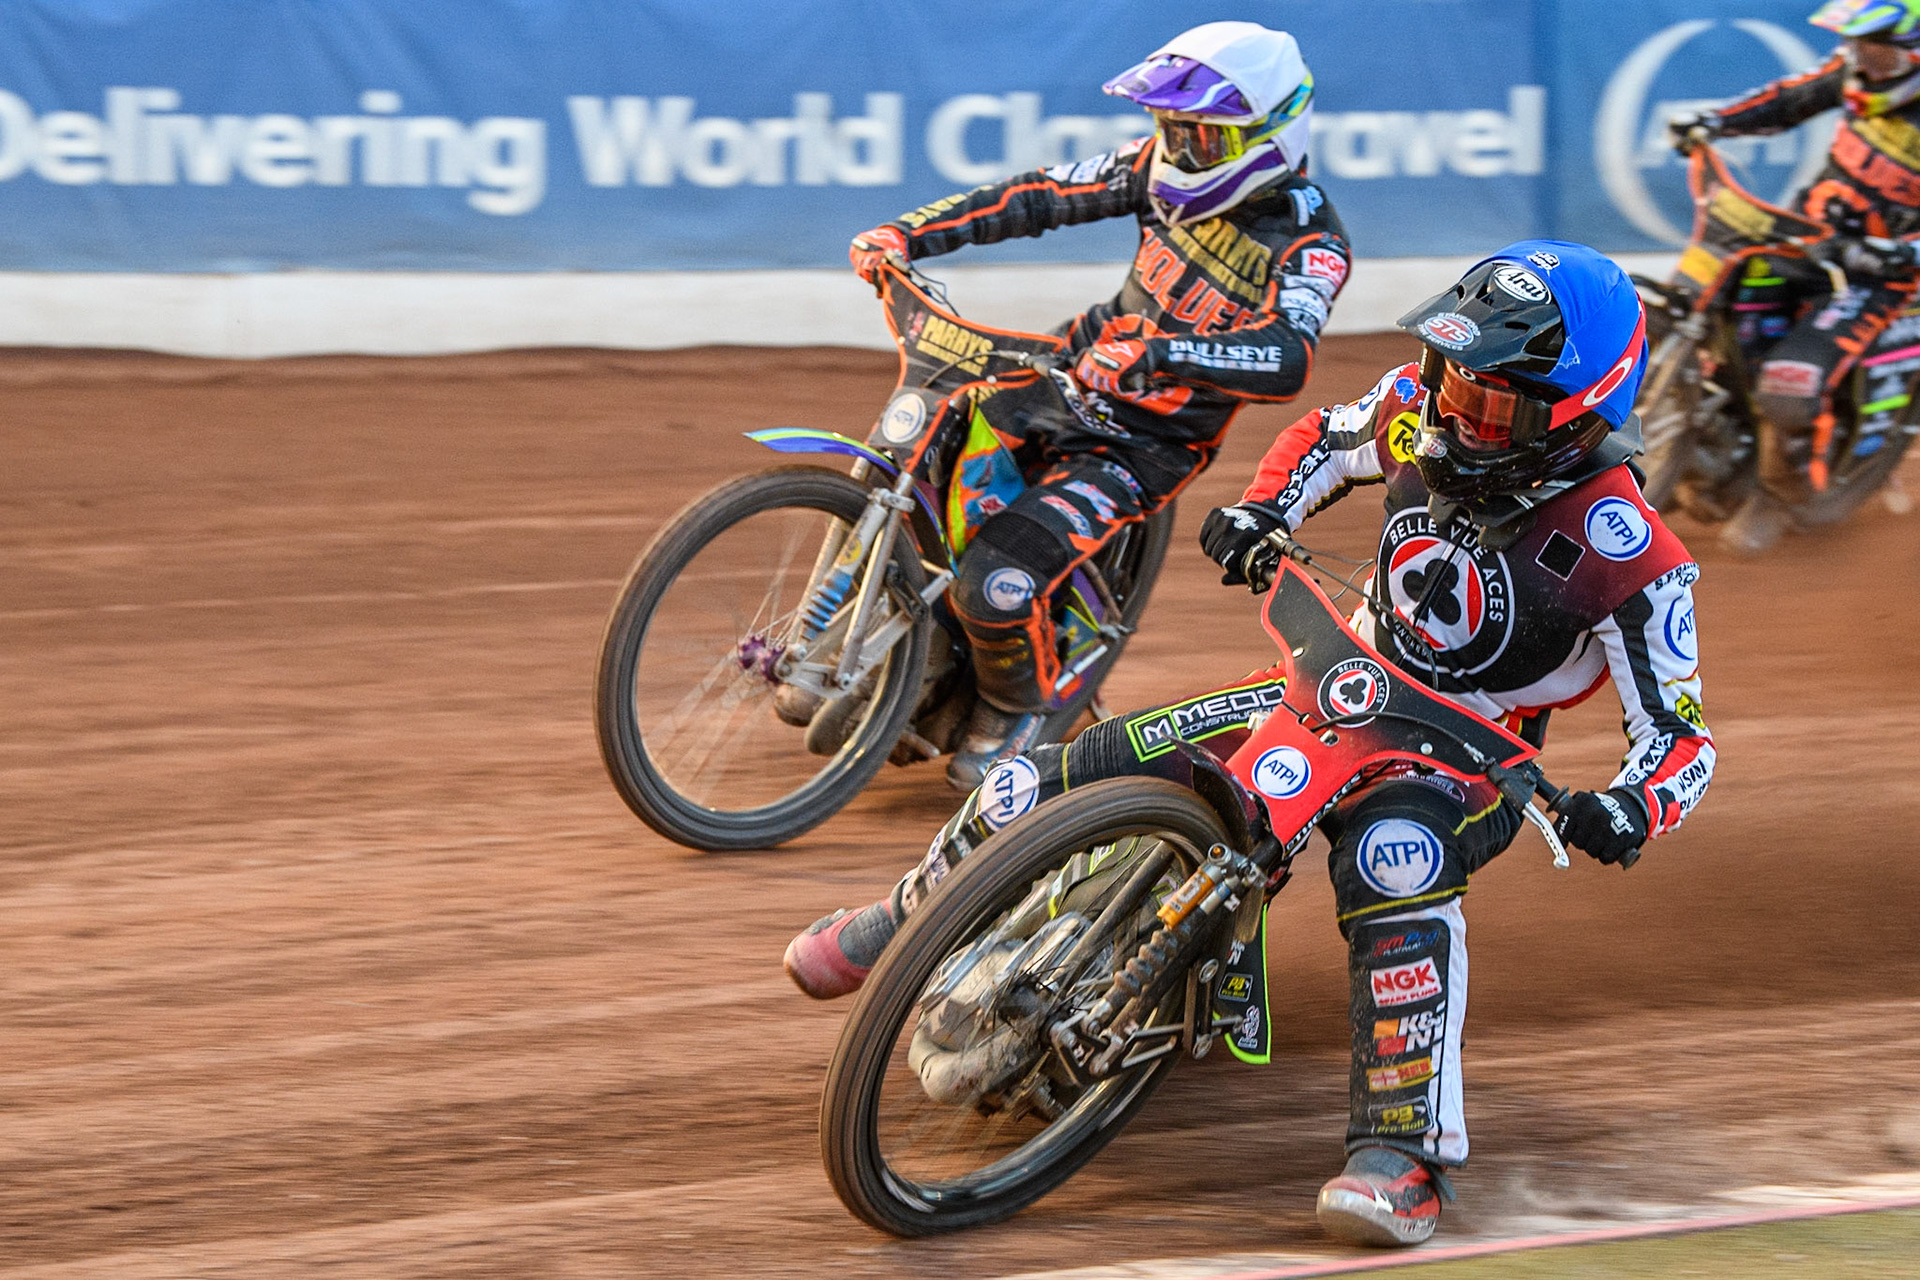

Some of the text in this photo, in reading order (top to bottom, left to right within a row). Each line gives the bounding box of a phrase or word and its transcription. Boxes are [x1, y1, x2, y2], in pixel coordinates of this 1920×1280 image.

[0, 86, 547, 215] Delivering
[566, 92, 903, 187] World
[1310, 85, 1546, 178] ravel
[1496, 271, 1547, 298] Arai
[920, 314, 995, 367] PARRYS
[1427, 318, 1472, 342] STS
[1169, 339, 1283, 363] BULLSEYE
[1600, 511, 1637, 546] ATPI
[1389, 517, 1505, 623] BELLE VUE ACES
[1337, 661, 1386, 704] BELLE VUE ACES
[1263, 759, 1299, 786] ATPI
[994, 769, 1015, 818] ATPI
[1372, 840, 1429, 871] ATPI
[1373, 963, 1436, 996] NGK
